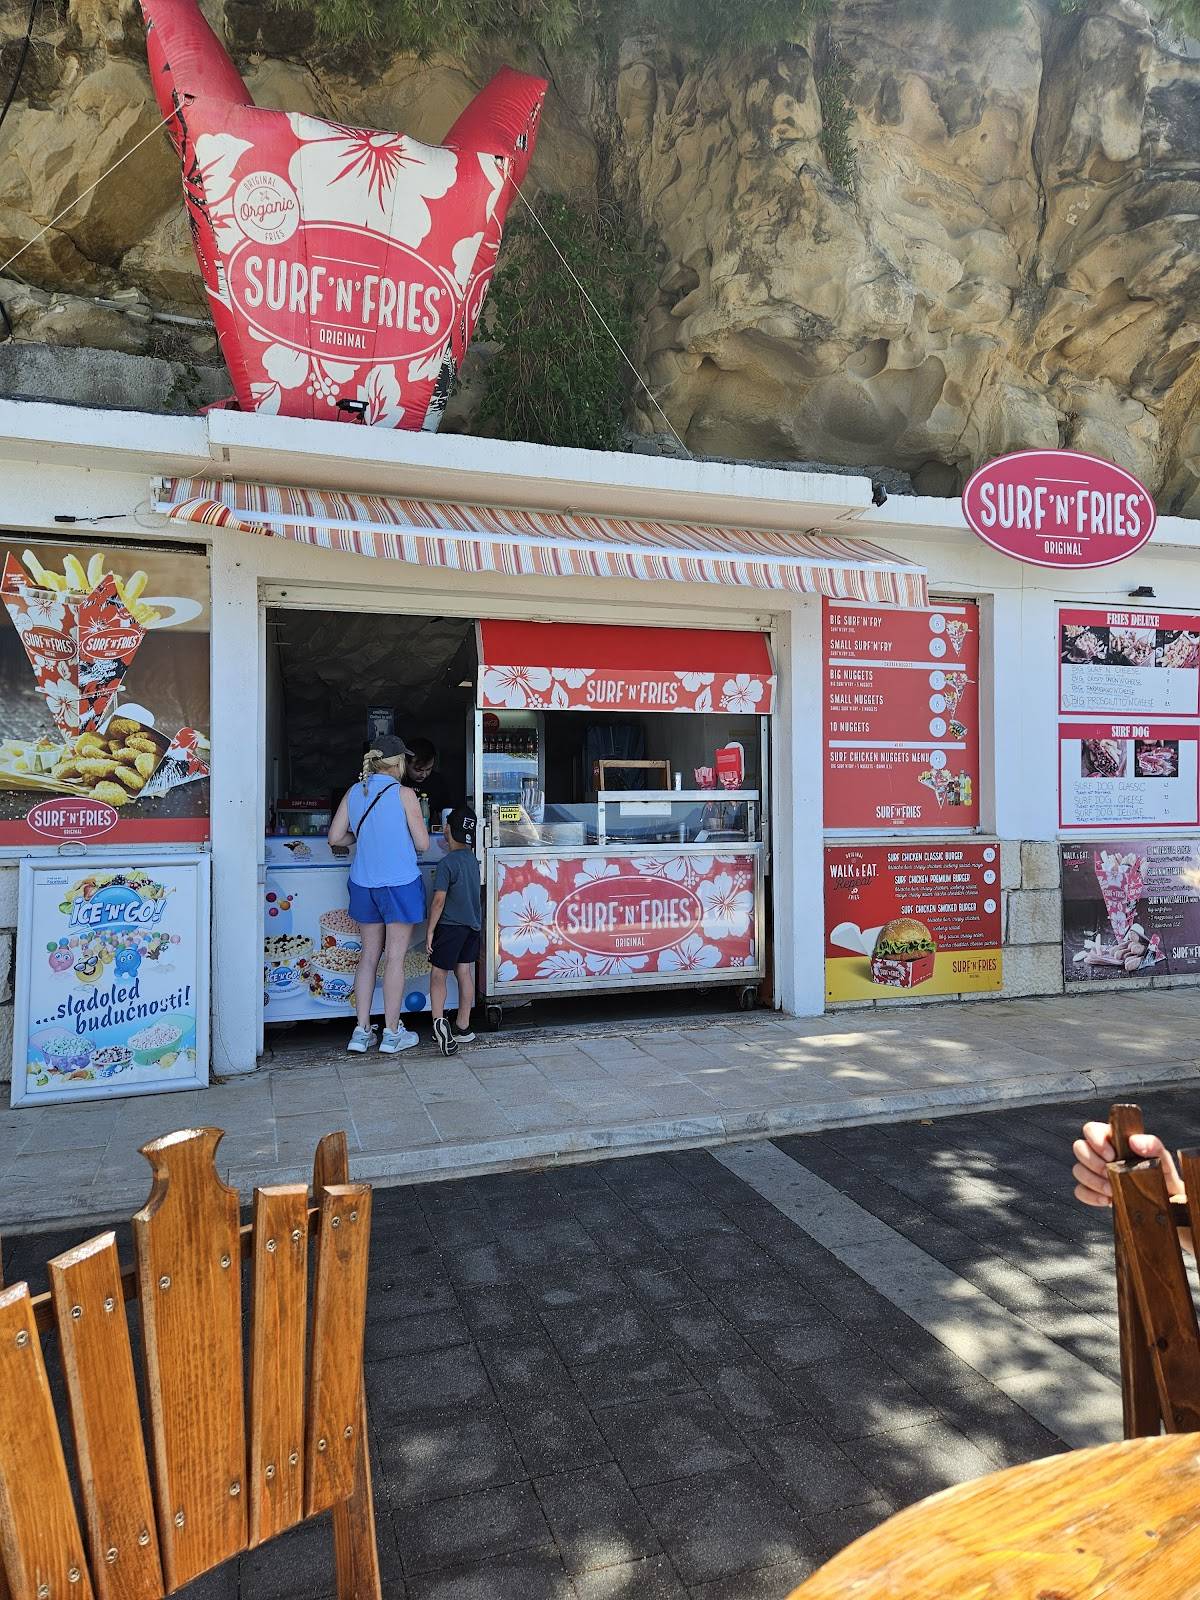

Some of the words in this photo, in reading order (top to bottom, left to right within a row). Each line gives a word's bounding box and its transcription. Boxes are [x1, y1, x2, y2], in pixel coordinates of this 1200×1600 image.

[239, 197, 295, 222] Organic
[264, 228, 286, 242] FRIES
[319, 328, 367, 349] ORIGINAL
[1044, 540, 1083, 556] ORIGINAL
[829, 614, 841, 625] BIG
[1106, 612, 1129, 625] FRIES
[1130, 614, 1160, 627] DELUXE
[830, 639, 851, 650] SMALL
[829, 669, 841, 680] BIG
[843, 669, 873, 681] NUGGETS
[830, 693, 851, 704] SMALL
[854, 694, 884, 705] NUGGETS
[830, 721, 837, 732] 10
[840, 721, 870, 732] NUGGETS
[1111, 725, 1131, 738] SURF
[1132, 725, 1150, 738] DOG
[830, 751, 847, 762] SURF
[849, 751, 878, 762] CHICKEN
[880, 752, 910, 763] NUGGETS
[911, 752, 930, 763] MENU
[829, 864, 853, 878] WALK
[615, 937, 645, 948] ORIGINAL
[75, 985, 191, 1035] budućnosti!
